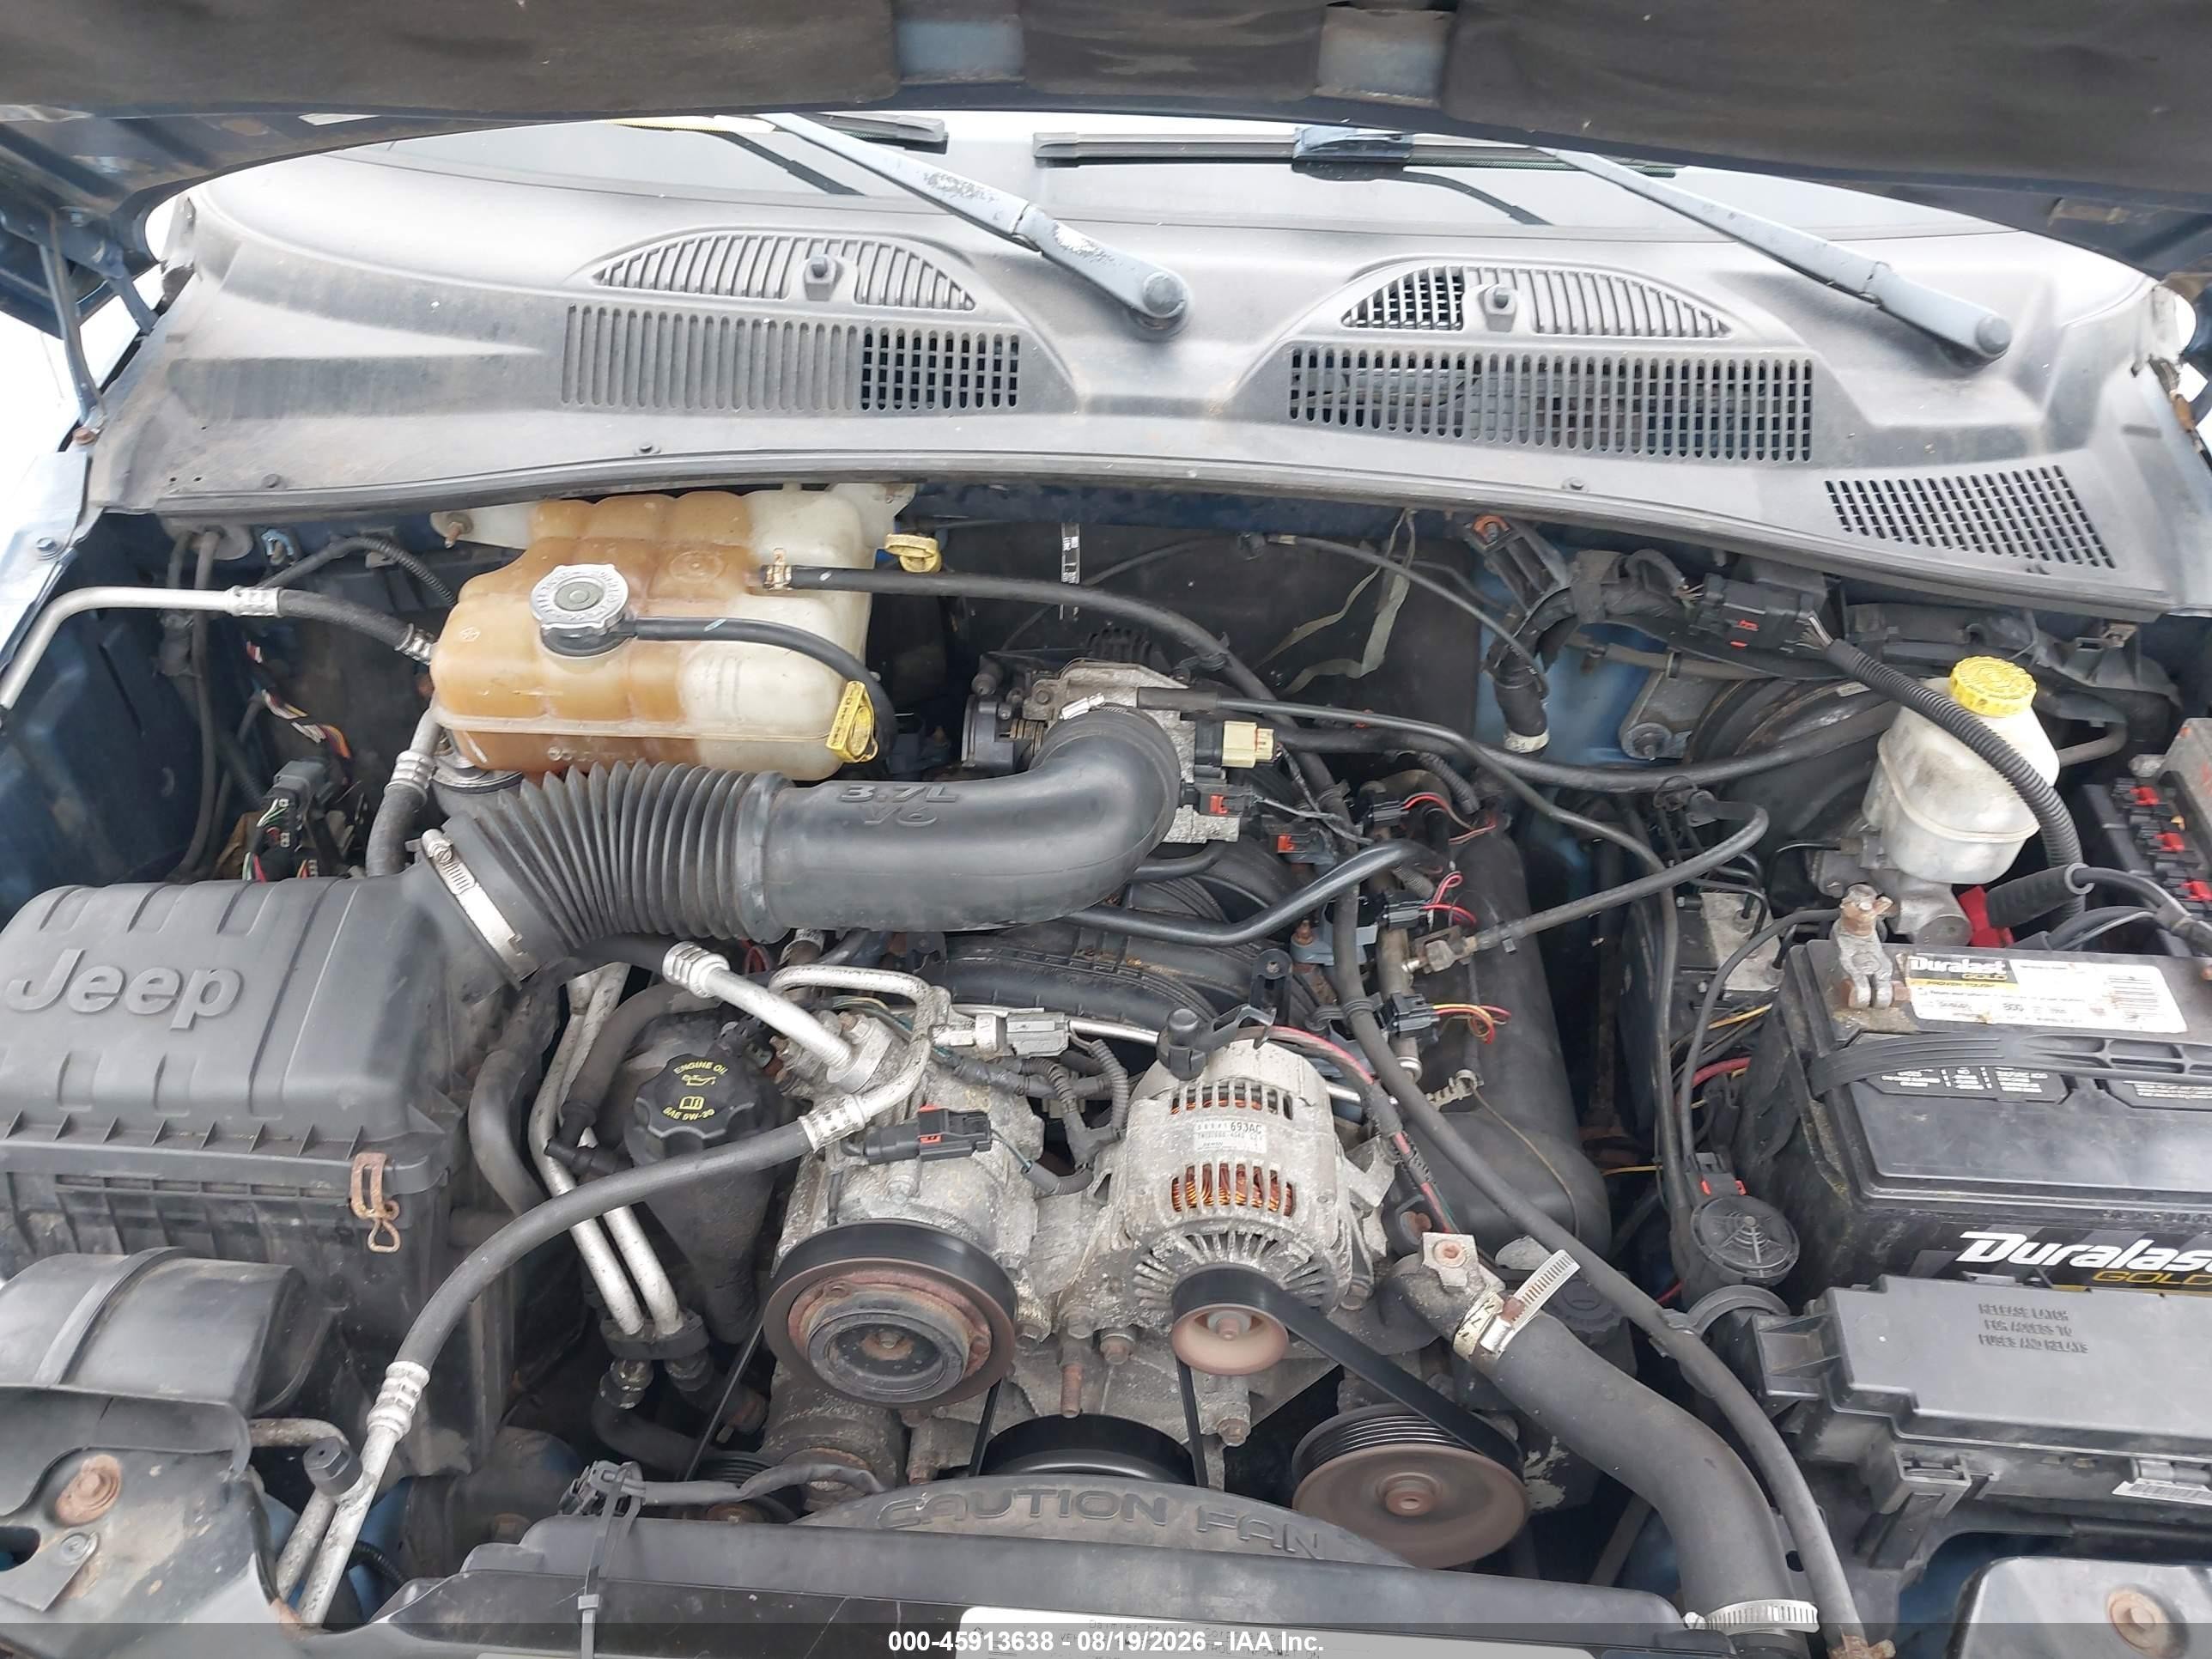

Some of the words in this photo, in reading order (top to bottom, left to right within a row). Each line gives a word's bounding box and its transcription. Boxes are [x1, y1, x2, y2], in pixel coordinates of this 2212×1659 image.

[839, 784, 957, 803] 3.7L
[864, 805, 938, 827] V6
[1907, 956, 2007, 974] Duralast
[4, 948, 245, 1030] Jeep
[673, 1061, 714, 1074] ENGINE
[713, 1064, 729, 1075] OIL
[1954, 1231, 2212, 1271] Duralas
[2093, 1271, 2212, 1285] GOLD
[2031, 1308, 2069, 1321] LATCH
[1984, 1319, 2008, 1331] FOR
[2055, 1325, 2073, 1337] TO
[1978, 1334, 2017, 1348] FUSES
[2019, 1338, 2043, 1350] AND
[877, 1489, 1168, 1528] CAUTION
[1197, 1504, 1321, 1560] FAN
